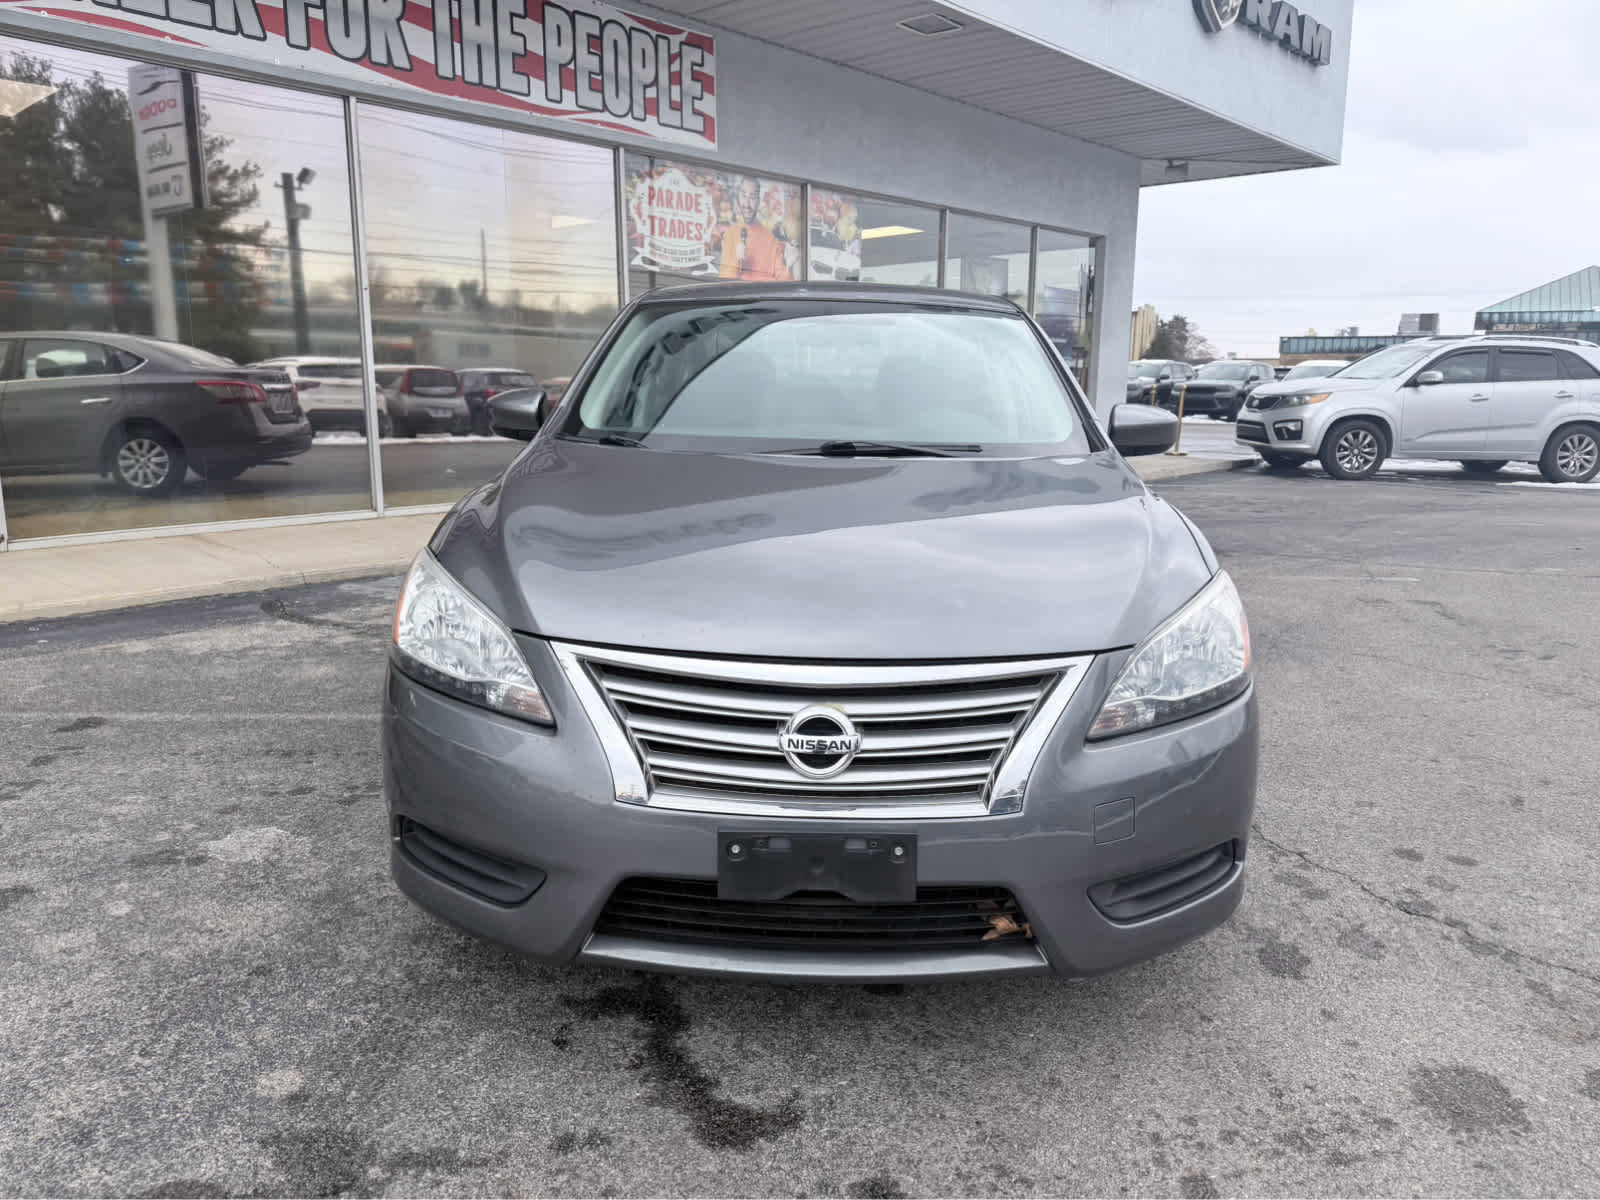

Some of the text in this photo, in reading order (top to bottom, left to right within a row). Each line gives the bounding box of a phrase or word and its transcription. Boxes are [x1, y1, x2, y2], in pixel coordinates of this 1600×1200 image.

[1243, 0, 1332, 65] RAM
[432, 0, 530, 97] THE
[542, 1, 706, 135] PEOPLE
[648, 186, 703, 213] PARADE
[648, 216, 703, 241] TRADES
[787, 738, 852, 750] NISSAN
